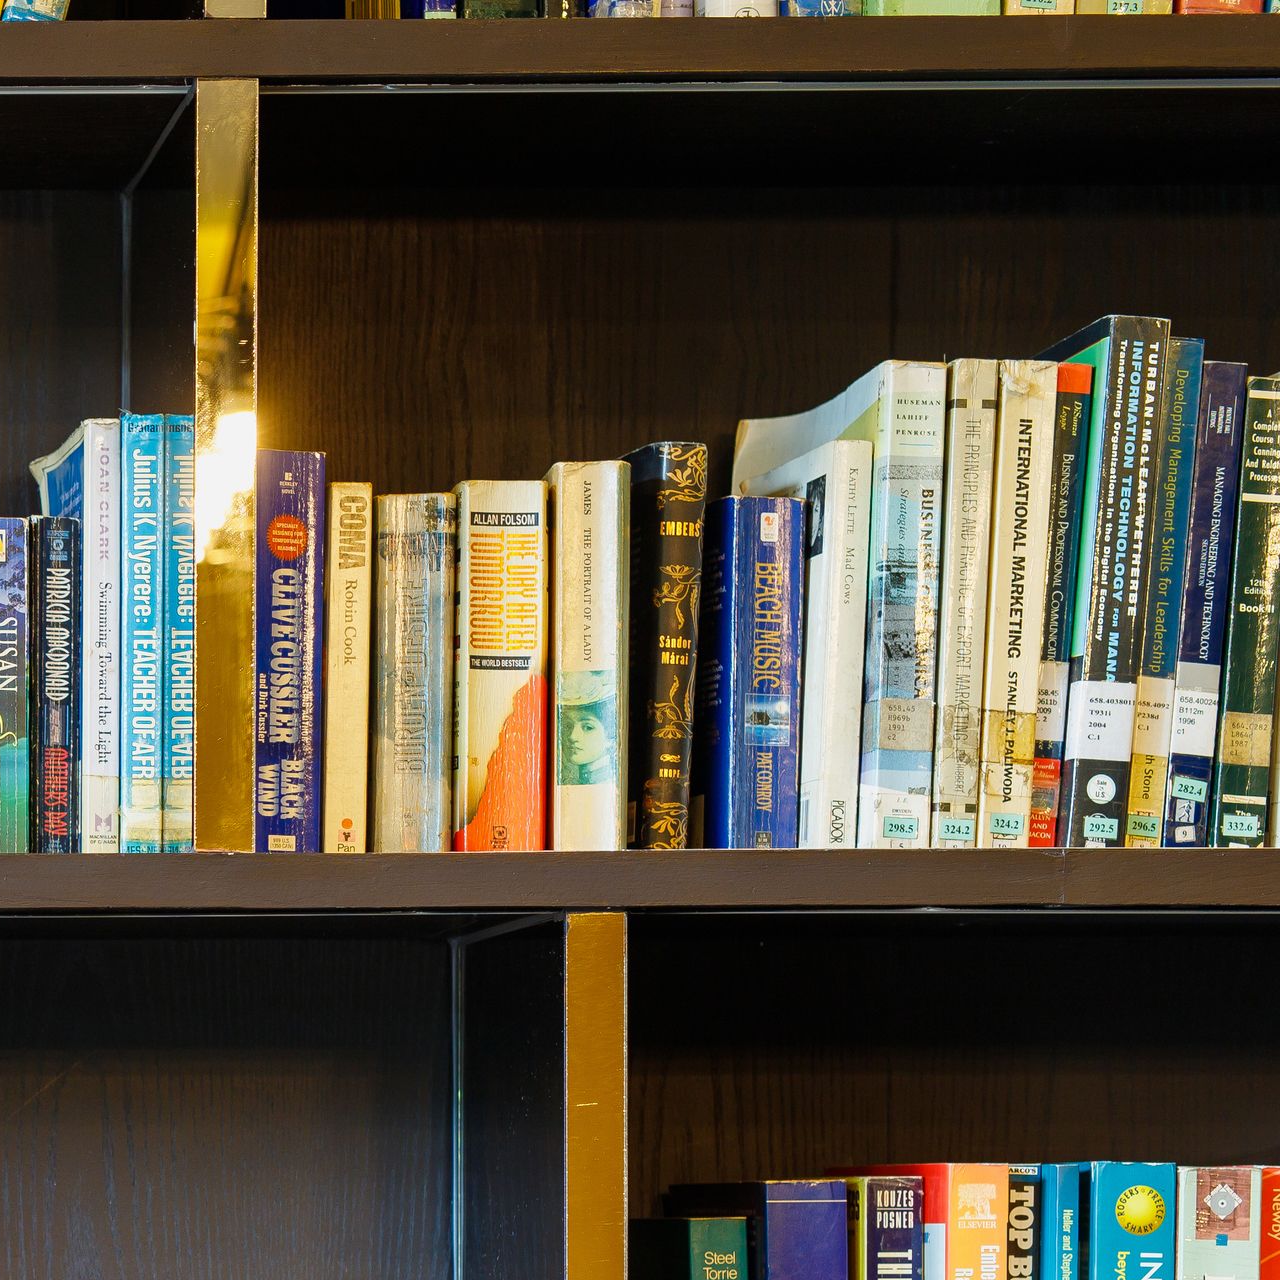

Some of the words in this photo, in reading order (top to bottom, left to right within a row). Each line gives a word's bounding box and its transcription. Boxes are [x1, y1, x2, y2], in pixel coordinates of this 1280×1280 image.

[1167, 369, 1189, 442] Developing
[133, 449, 157, 508] Julius
[1011, 418, 1032, 550] INTERNATIONAL
[1163, 449, 1184, 532] Management
[133, 512, 156, 531] K.
[1161, 537, 1179, 571] Skills
[127, 535, 157, 624] Nyerere:
[344, 579, 358, 623] Robin
[1159, 578, 1174, 596] for
[97, 582, 113, 648] Swimming
[1007, 556, 1027, 658] MARKETING
[343, 626, 357, 665] Cook
[1149, 602, 1171, 672] Leadership
[98, 652, 112, 701] Toward
[131, 628, 156, 713] TEACHER
[98, 705, 112, 726] the
[132, 717, 155, 739] OF
[97, 730, 112, 763] Light
[829, 800, 846, 843] PICADOR
[1009, 1185, 1035, 1249] TOP
[704, 1251, 736, 1264] Steel
